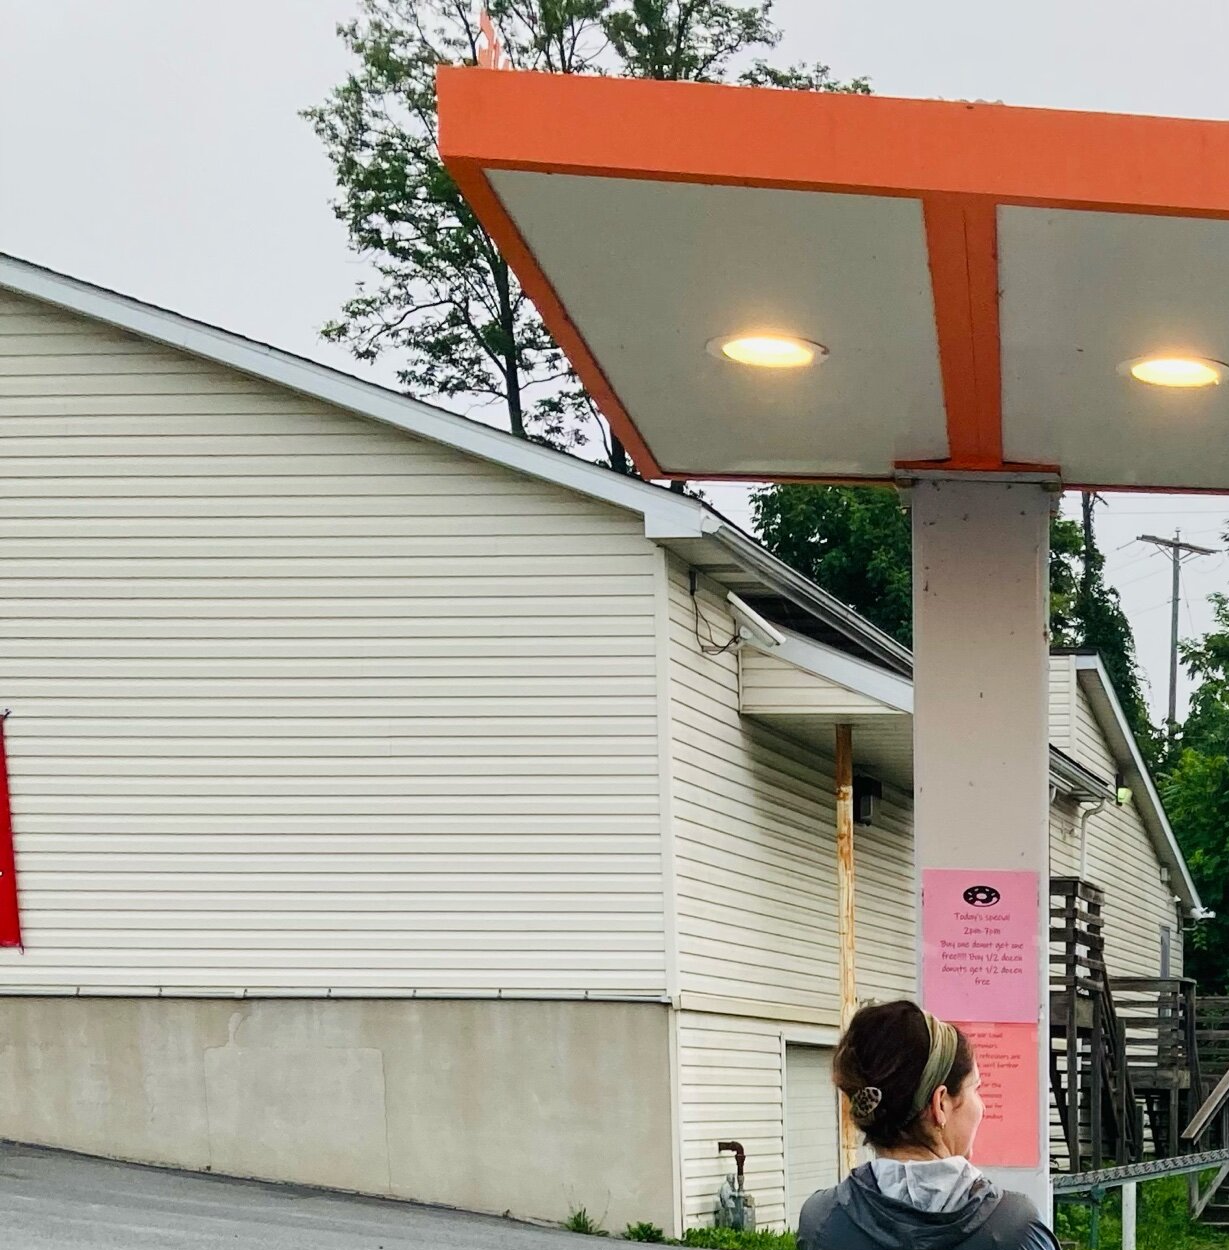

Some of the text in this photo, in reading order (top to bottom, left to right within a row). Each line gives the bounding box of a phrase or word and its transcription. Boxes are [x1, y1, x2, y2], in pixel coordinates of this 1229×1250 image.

[953, 912, 1010, 921] Today's special
[940, 940, 955, 949] Buy
[995, 942, 1008, 950] get
[969, 953, 983, 961] Buy
[986, 953, 999, 961] 1/2
[1001, 953, 1023, 961] dozen
[969, 967, 982, 975] get
[985, 966, 999, 974] 1/2
[975, 977, 991, 985] free
